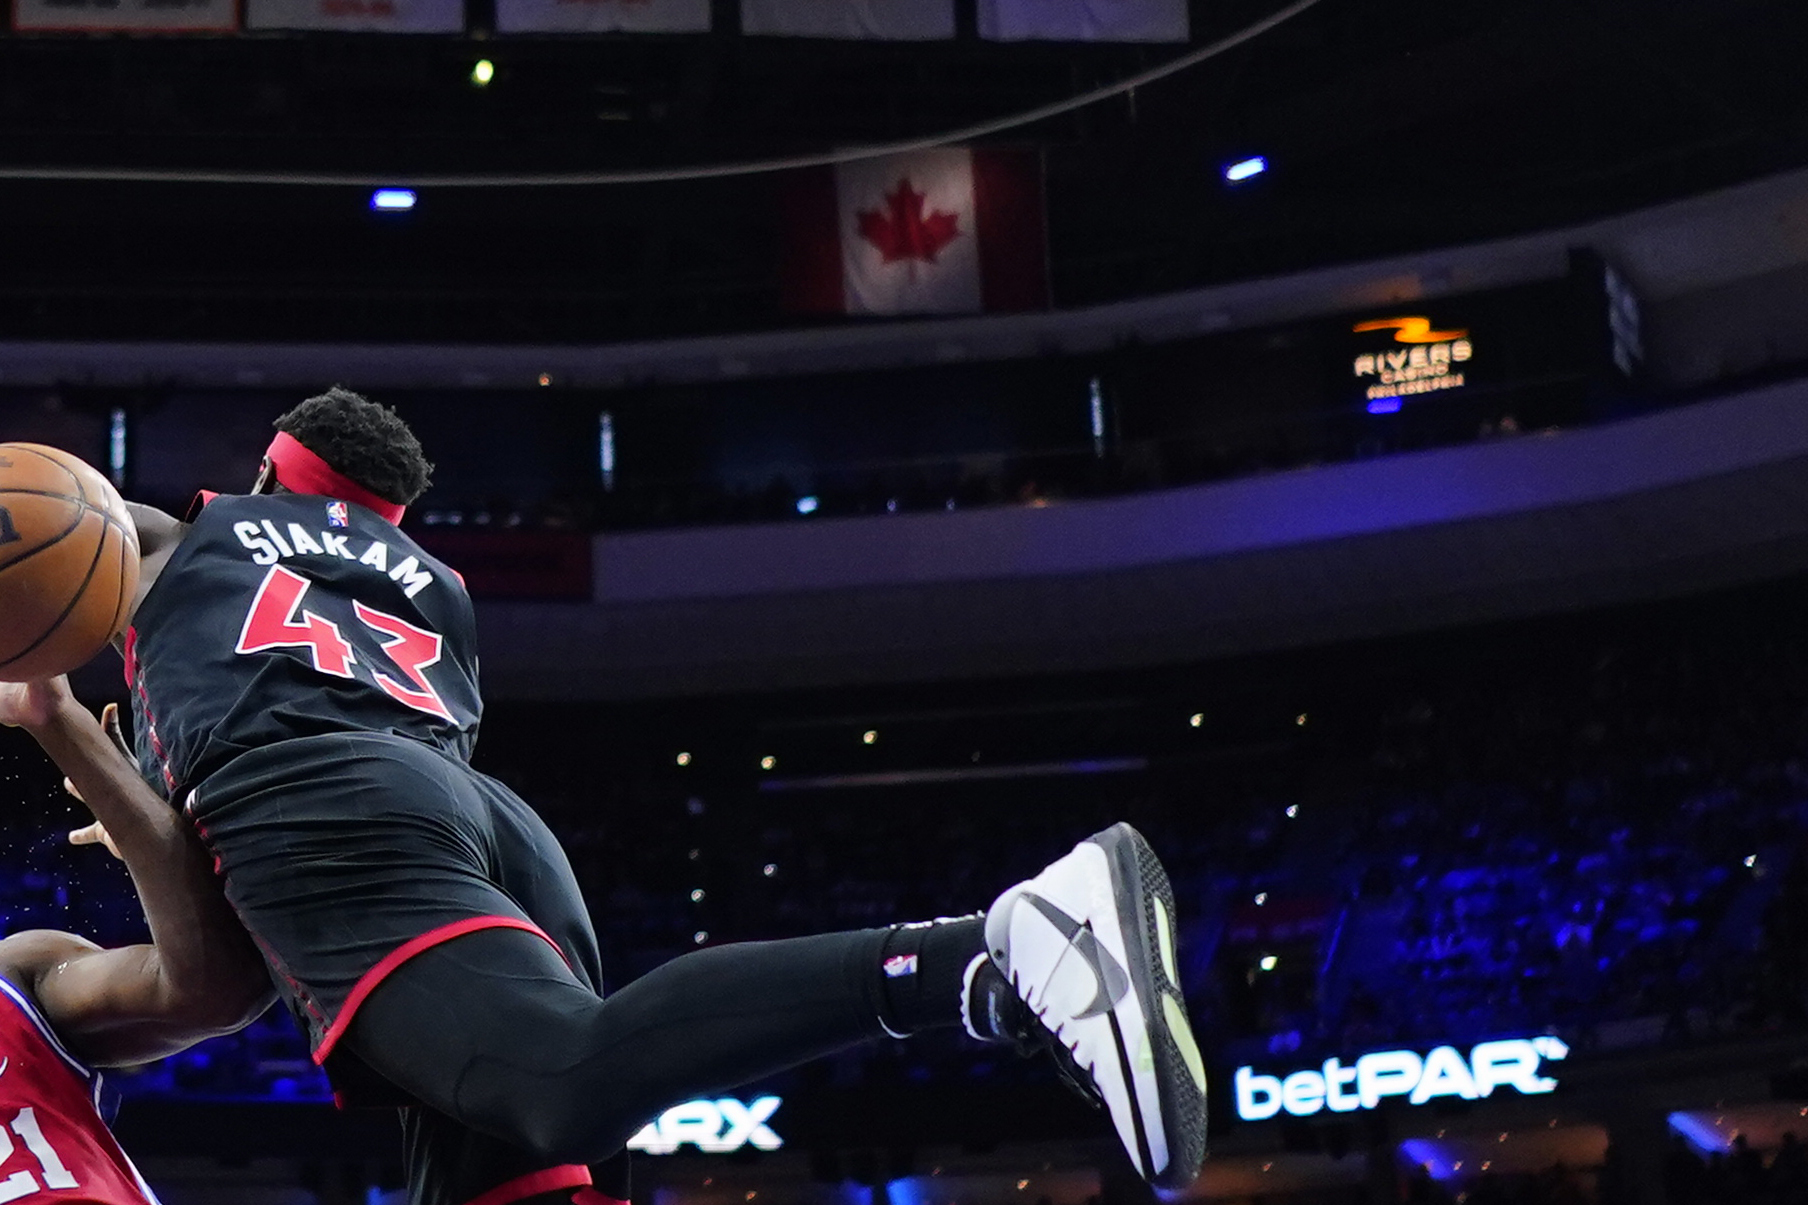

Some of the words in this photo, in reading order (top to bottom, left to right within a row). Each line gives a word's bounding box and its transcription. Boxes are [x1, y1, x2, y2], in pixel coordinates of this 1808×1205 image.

[1354, 339, 1473, 378] RIVERS
[1380, 363, 1449, 385] CASINO
[233, 519, 434, 599] SIAKAM
[235, 563, 460, 726] 43
